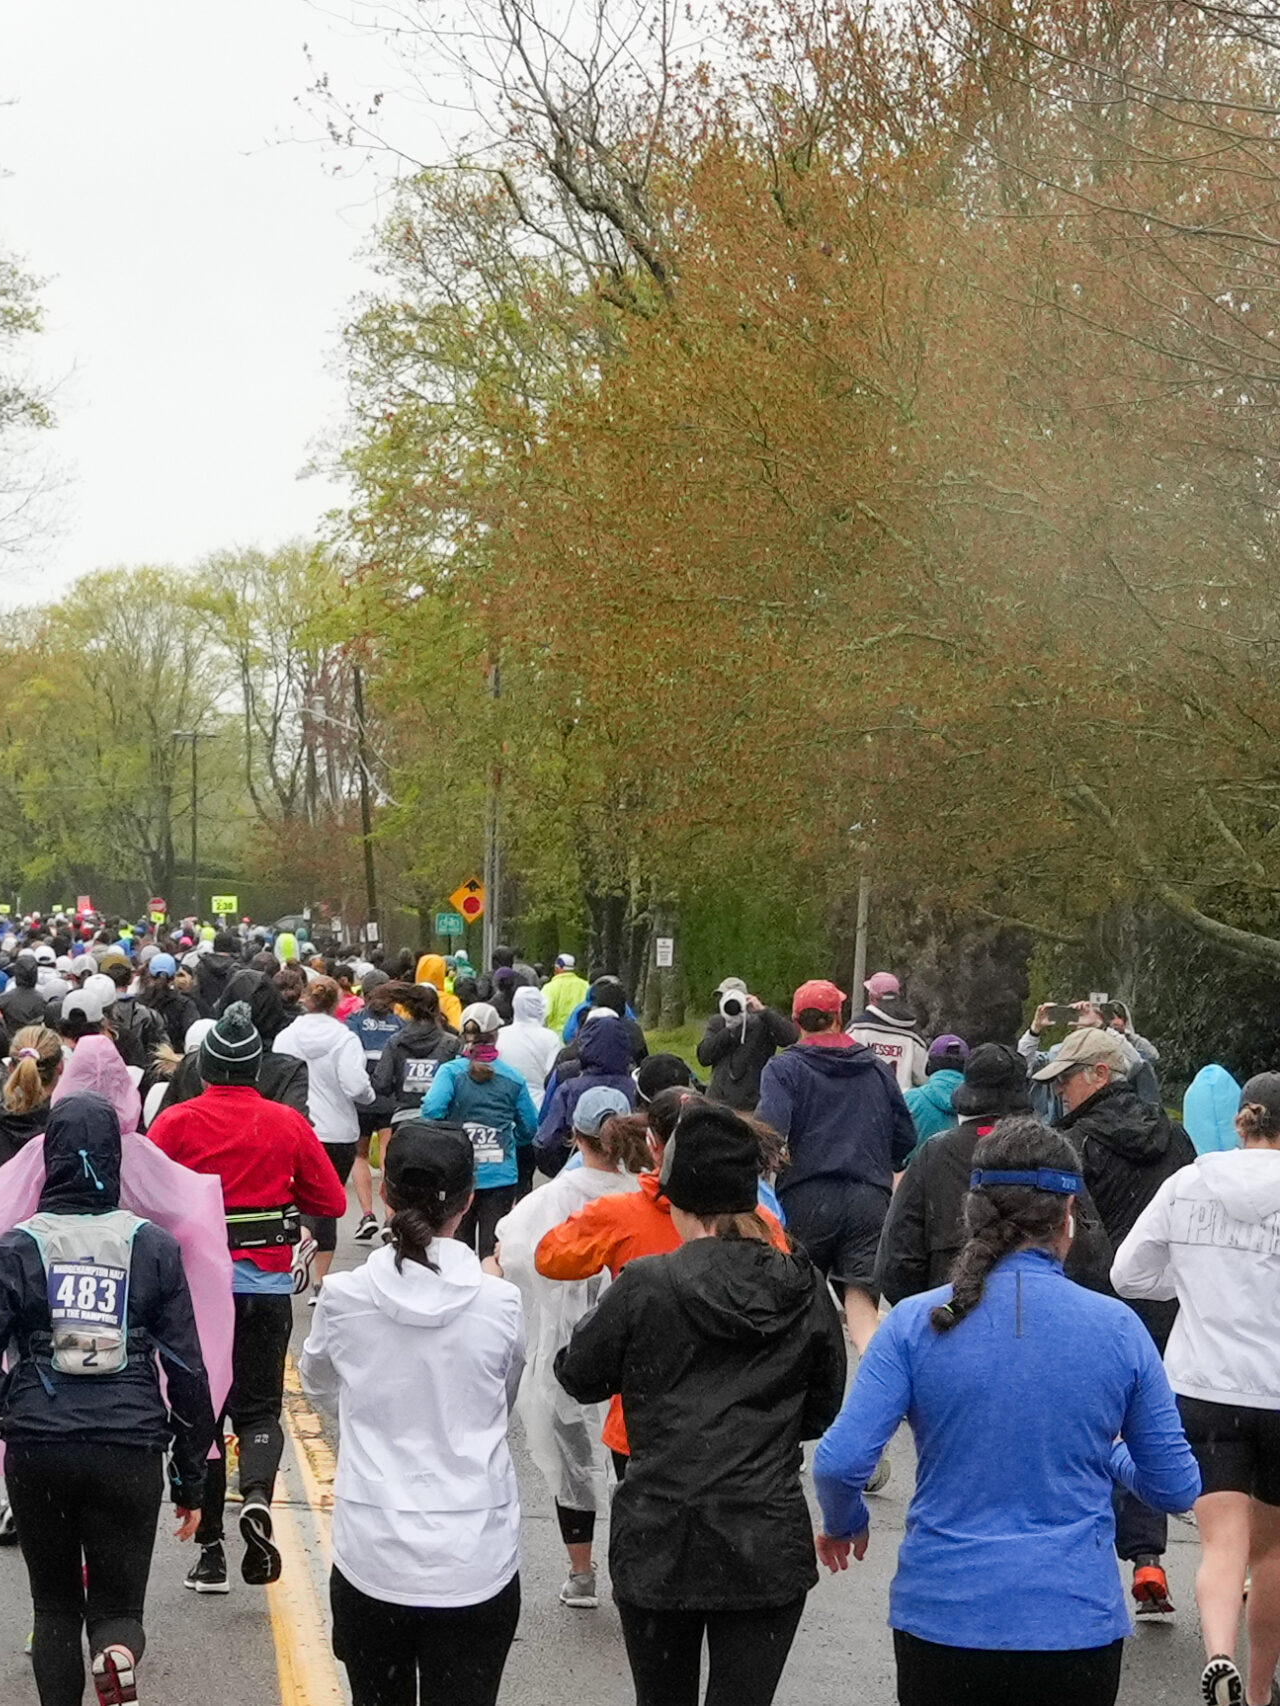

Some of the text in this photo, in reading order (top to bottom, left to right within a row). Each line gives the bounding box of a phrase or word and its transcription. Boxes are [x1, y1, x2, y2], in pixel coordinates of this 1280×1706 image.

[408, 1063, 434, 1077] 782
[466, 1128, 497, 1144] 732
[56, 1275, 117, 1313] 483
